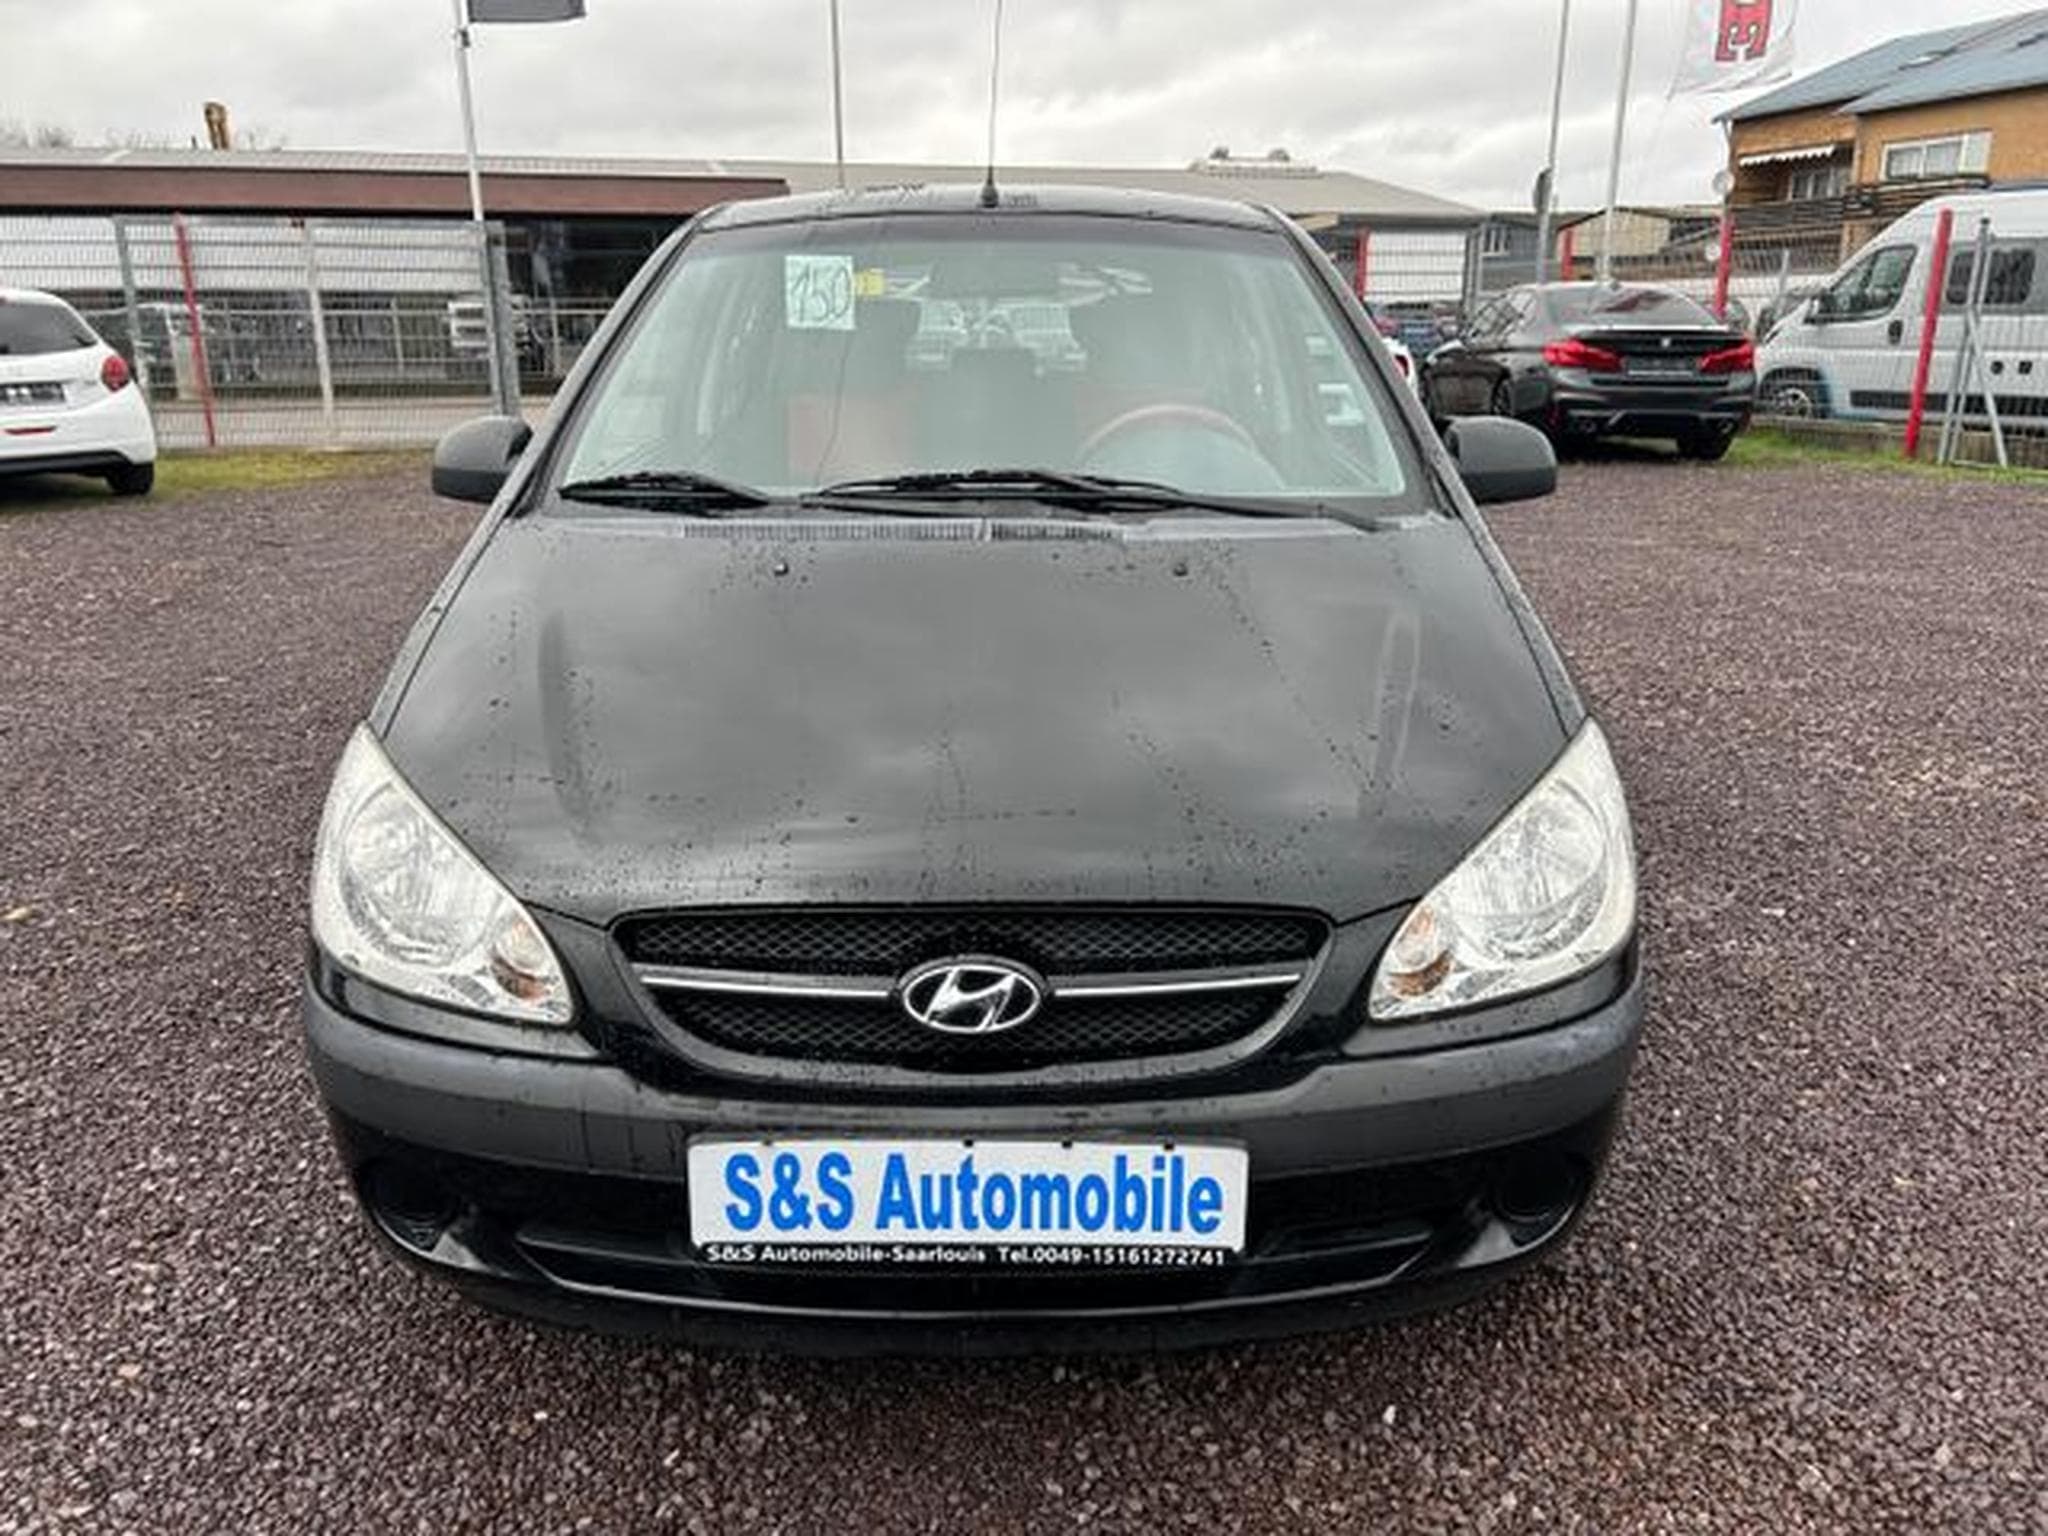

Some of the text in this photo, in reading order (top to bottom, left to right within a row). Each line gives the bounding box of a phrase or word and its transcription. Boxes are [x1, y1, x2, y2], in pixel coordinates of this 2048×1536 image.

[791, 263, 851, 321] 150
[724, 1152, 1223, 1234] S&S Automobile
[706, 1245, 756, 1262] S&S
